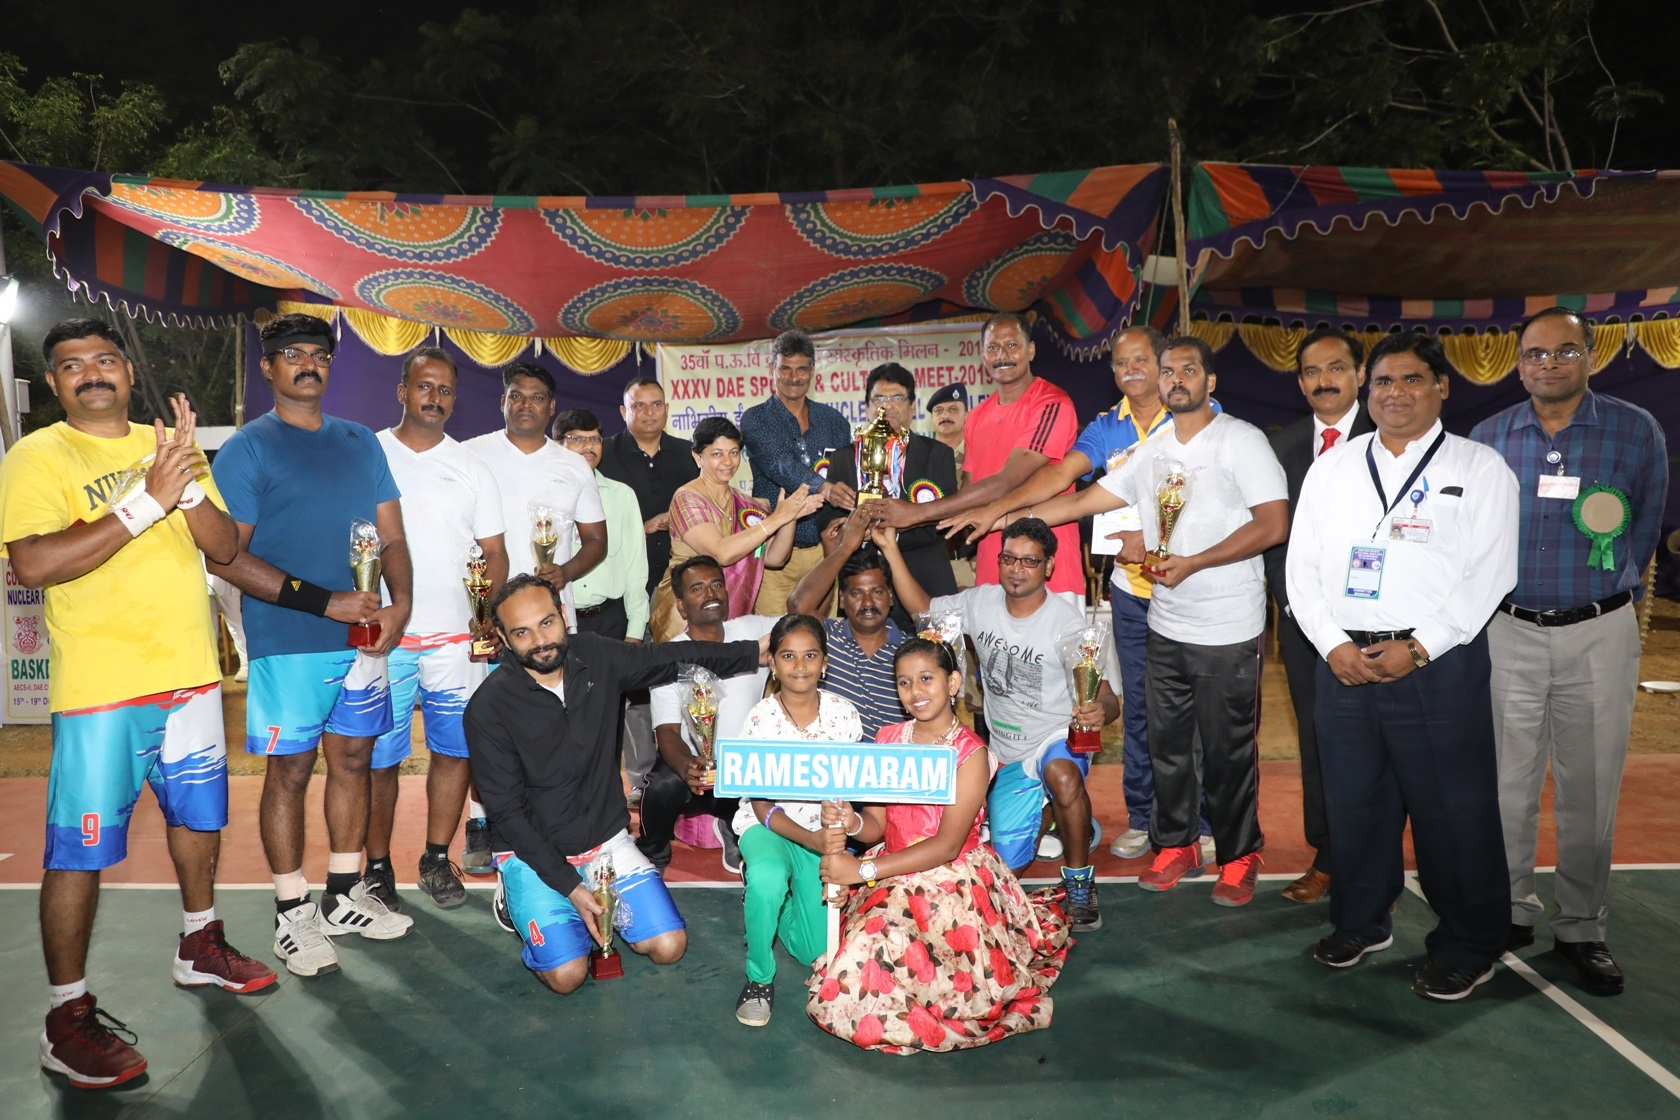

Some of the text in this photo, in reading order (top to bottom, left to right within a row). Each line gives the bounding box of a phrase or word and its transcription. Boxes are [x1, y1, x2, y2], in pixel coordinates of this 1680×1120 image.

[898, 338, 939, 359] मिलन
[959, 340, 983, 357] 201
[671, 378, 711, 400] XXXV
[716, 376, 745, 398] DAE
[815, 374, 825, 393] &
[7, 589, 41, 605] NUCLEAR
[977, 631, 1044, 665] AWESOME
[265, 725, 282, 754] 7
[723, 752, 947, 791] RAMESWARAM
[82, 812, 100, 847] 9
[528, 919, 545, 947] 4
